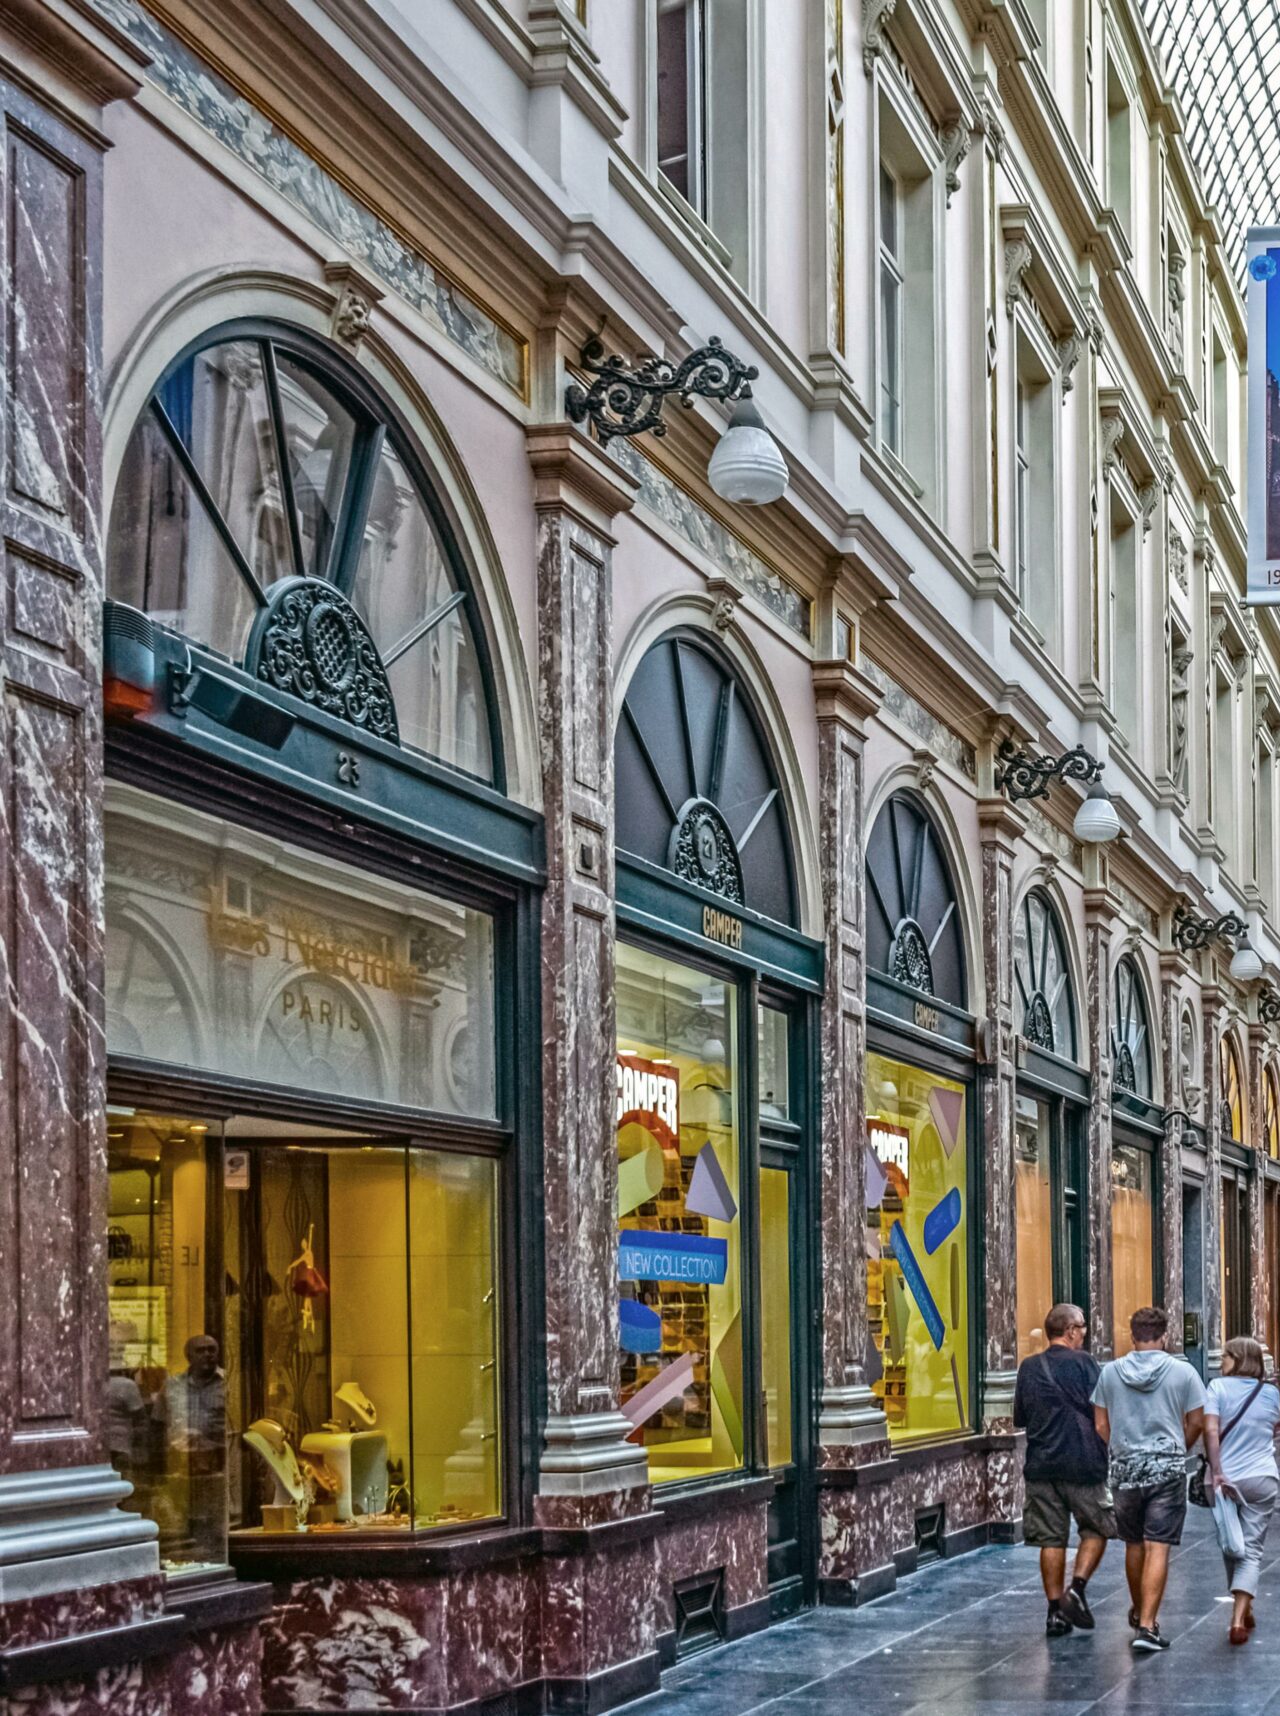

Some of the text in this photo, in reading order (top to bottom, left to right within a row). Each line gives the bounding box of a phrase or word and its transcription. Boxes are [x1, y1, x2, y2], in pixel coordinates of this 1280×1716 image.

[703, 905, 742, 950] CAMPER
[282, 991, 361, 1032] PARIS
[914, 1002, 939, 1032] CAMPER
[626, 1252, 718, 1279] NEW COLLECTION
